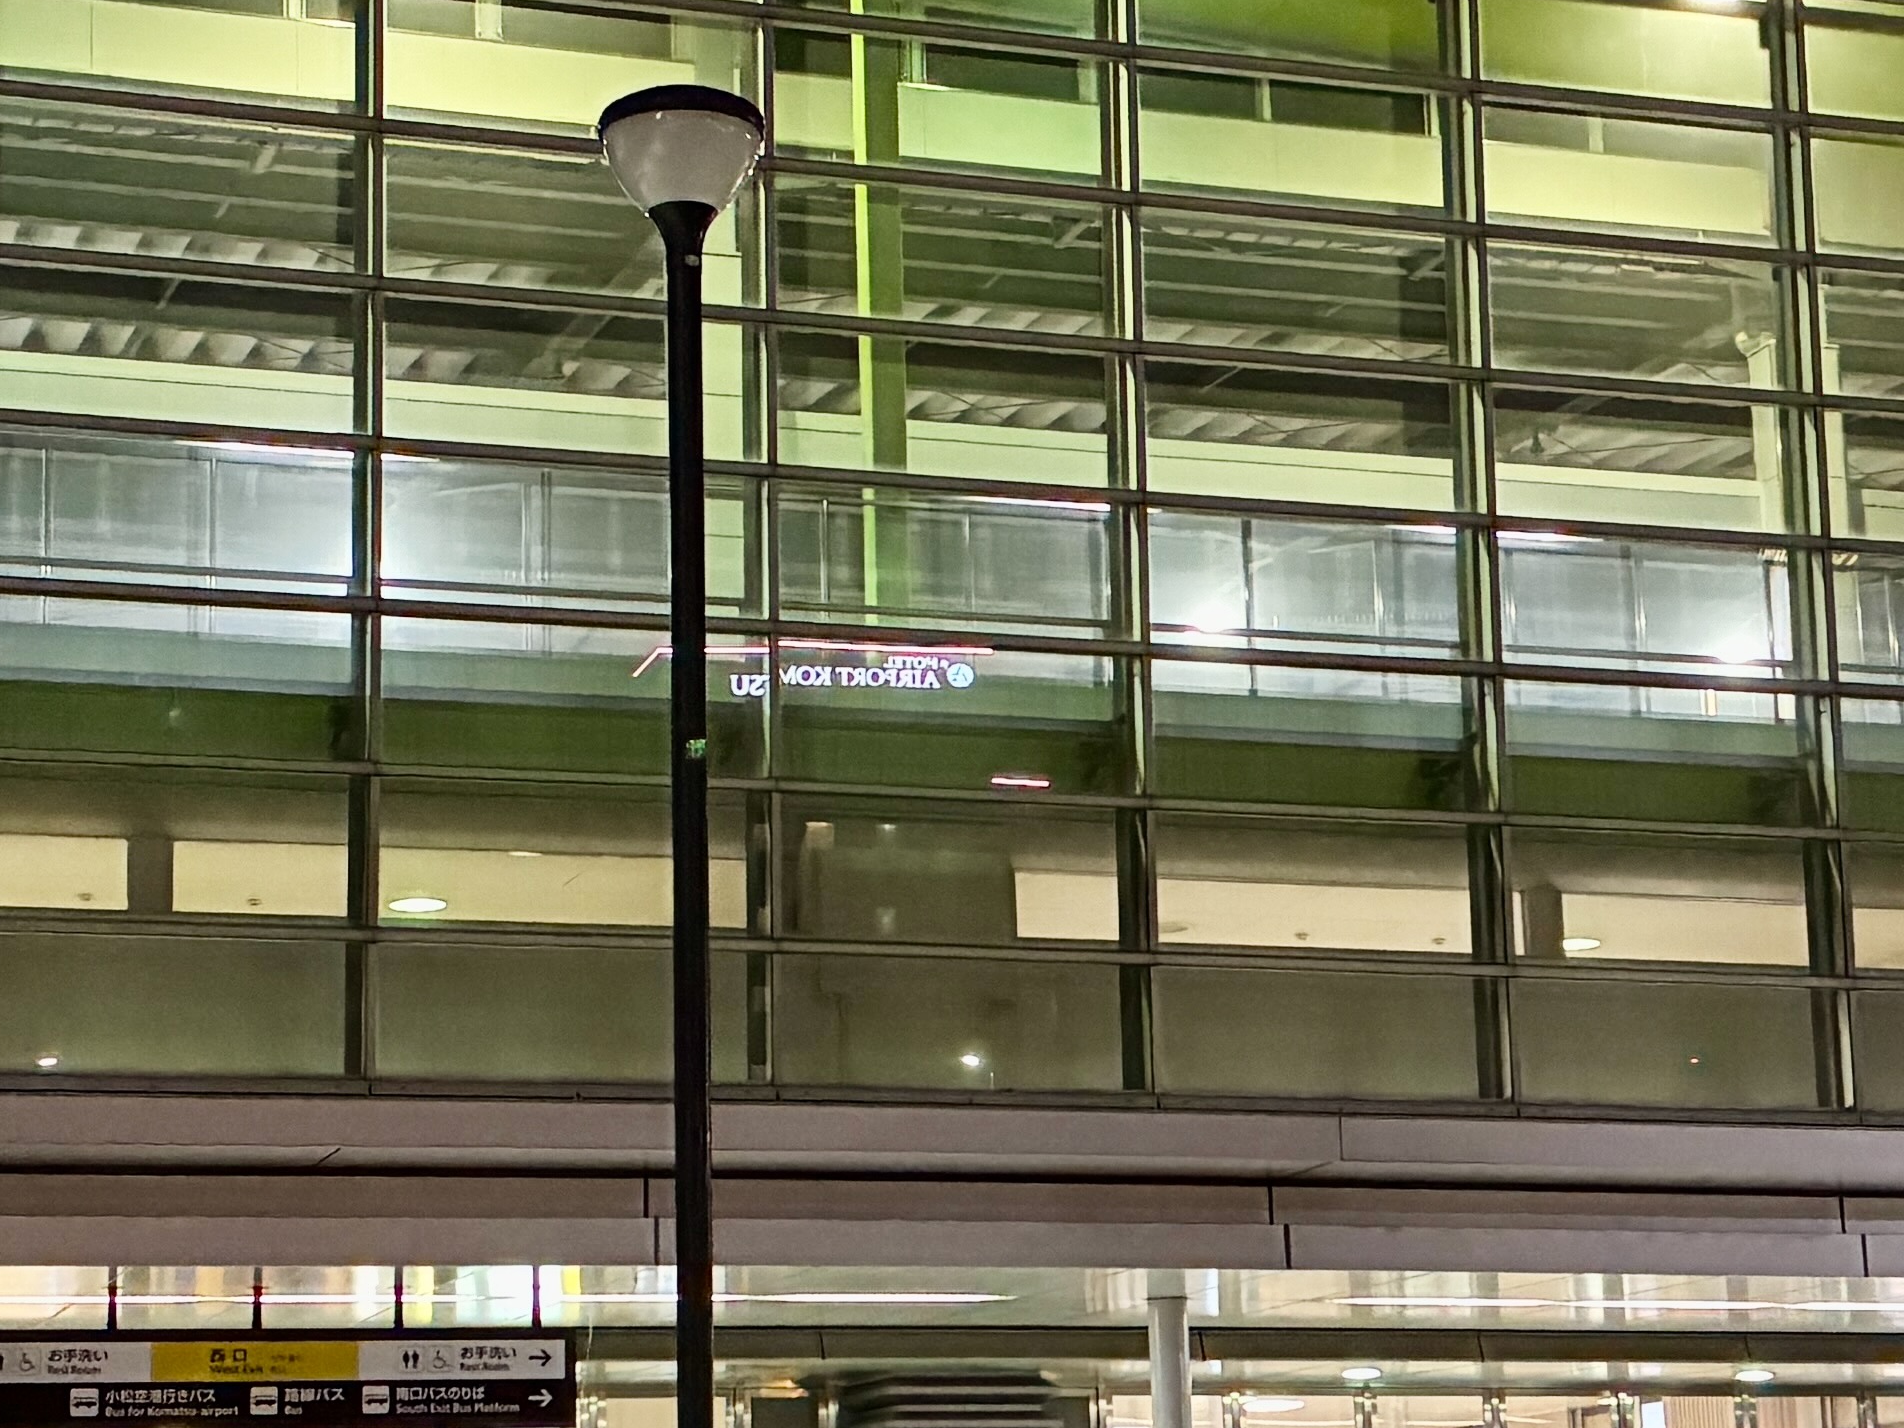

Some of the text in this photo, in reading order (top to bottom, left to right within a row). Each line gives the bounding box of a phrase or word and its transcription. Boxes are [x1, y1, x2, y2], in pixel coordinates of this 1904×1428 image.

[48, 1348, 109, 1363] お手洗い
[459, 1346, 517, 1360] お手洗い
[104, 1388, 217, 1404] 小松空港行きバス
[395, 1386, 486, 1401] 南口バスのりば
